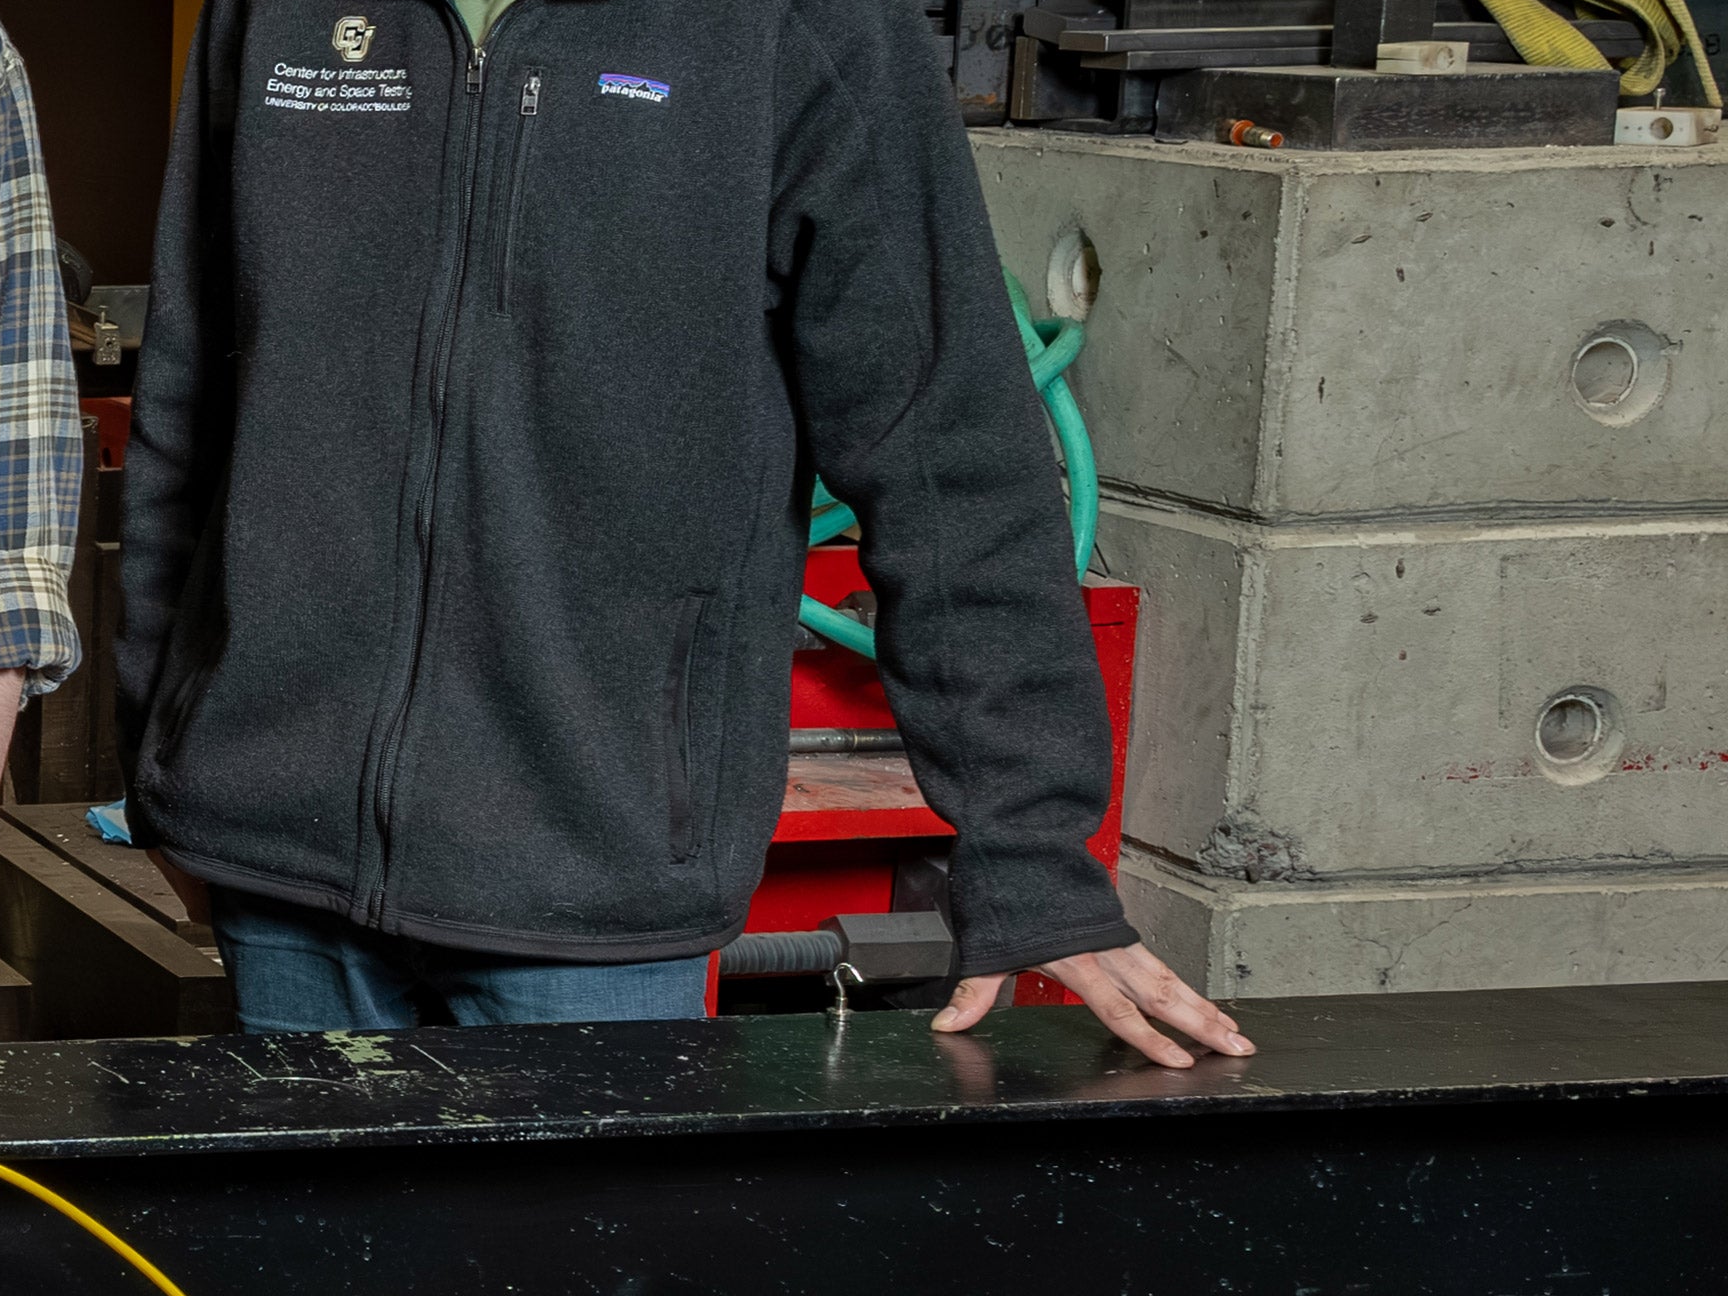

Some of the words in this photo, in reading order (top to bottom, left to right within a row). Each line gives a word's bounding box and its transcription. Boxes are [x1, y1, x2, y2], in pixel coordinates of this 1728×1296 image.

[274, 62, 318, 80] Center
[320, 67, 337, 80] for
[266, 78, 312, 99] Energy
[314, 85, 337, 98] and
[339, 84, 376, 99] Space
[601, 85, 665, 102] patagonia
